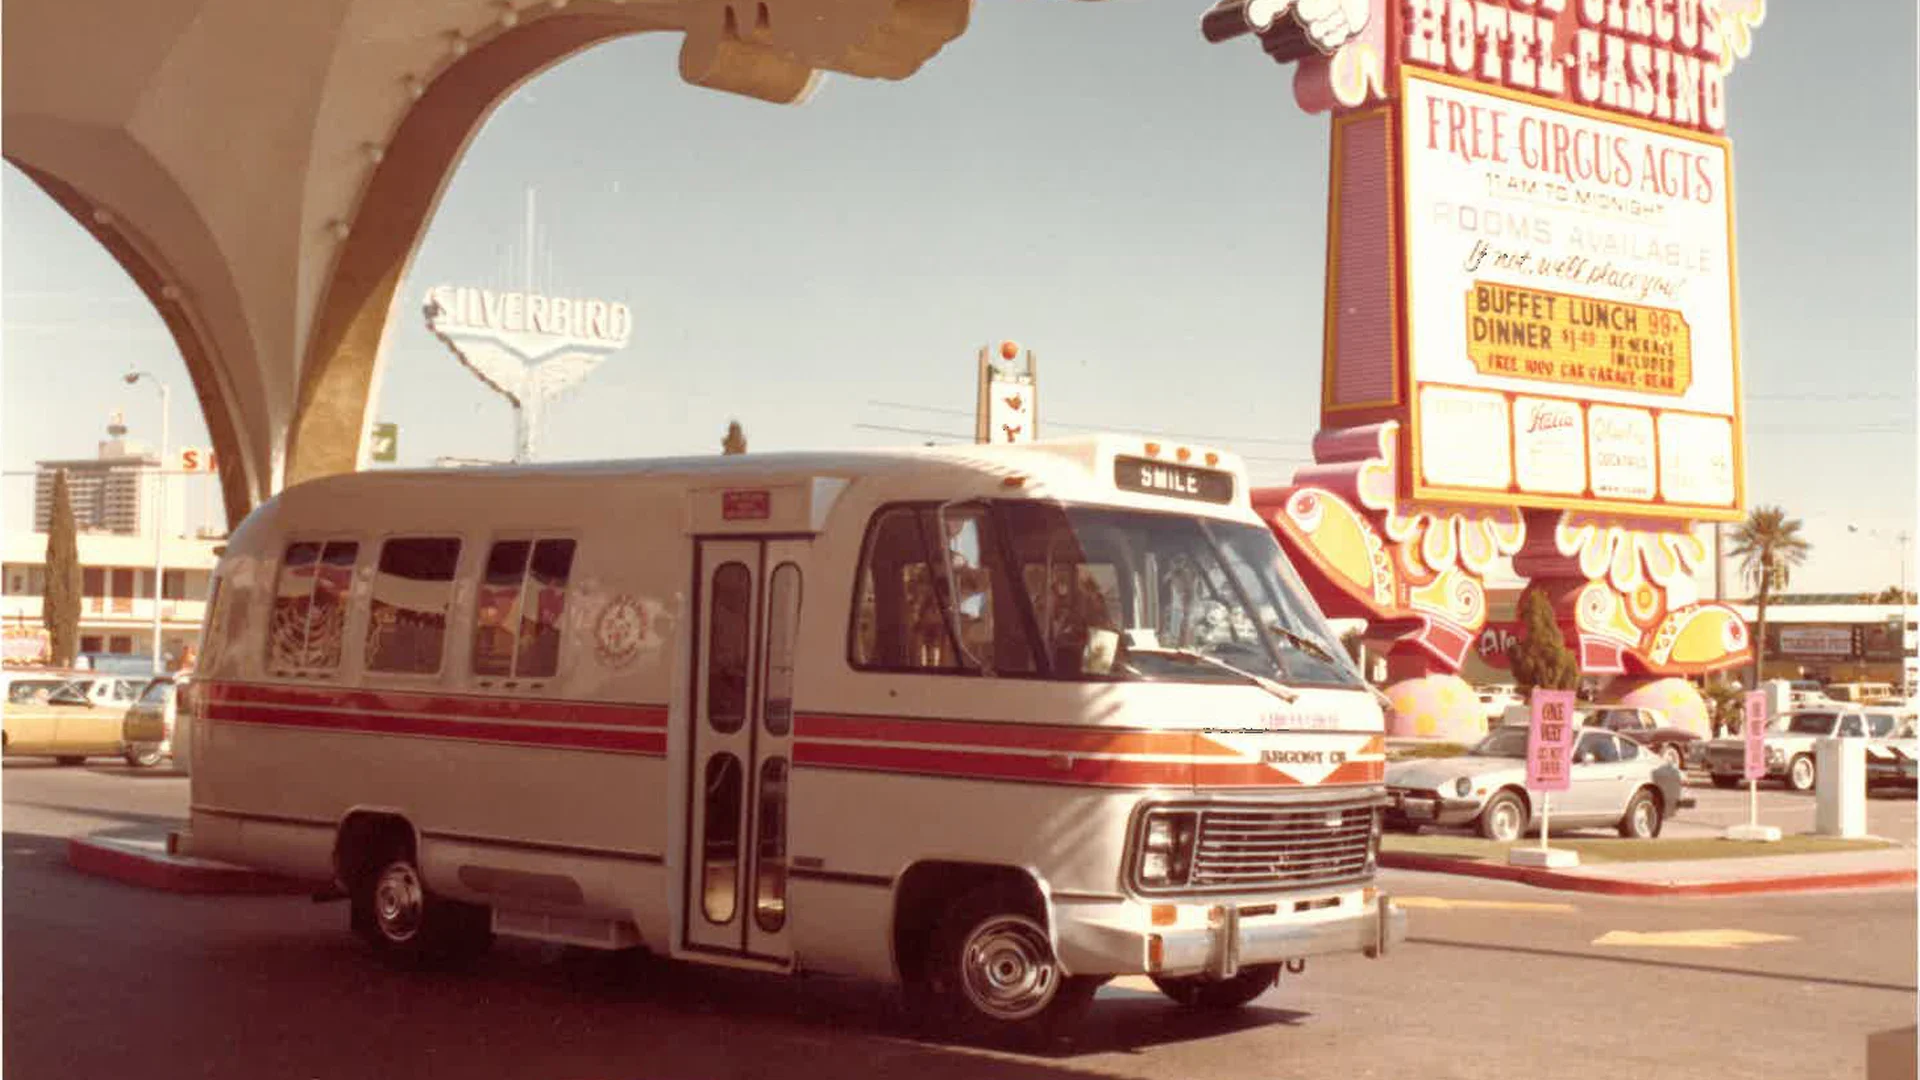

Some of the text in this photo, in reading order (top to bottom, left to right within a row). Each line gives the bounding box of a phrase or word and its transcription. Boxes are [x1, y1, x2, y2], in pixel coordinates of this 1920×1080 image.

[1408, 0, 1726, 131] HOTEL CASINO
[1426, 96, 1713, 204] FREE CIRCUS ACTS
[1433, 201, 1712, 272] ROOMS AVAILABLE
[430, 285, 633, 342] SILVERBIRD
[1476, 286, 1556, 321] BUFFET
[1568, 299, 1637, 331] LUNCH
[1473, 315, 1553, 350] DINNER
[1489, 353, 1518, 373] FREE
[1560, 363, 1586, 379] CAR
[1610, 351, 1675, 373] INCLUDED
[1140, 463, 1198, 494] SMILE
